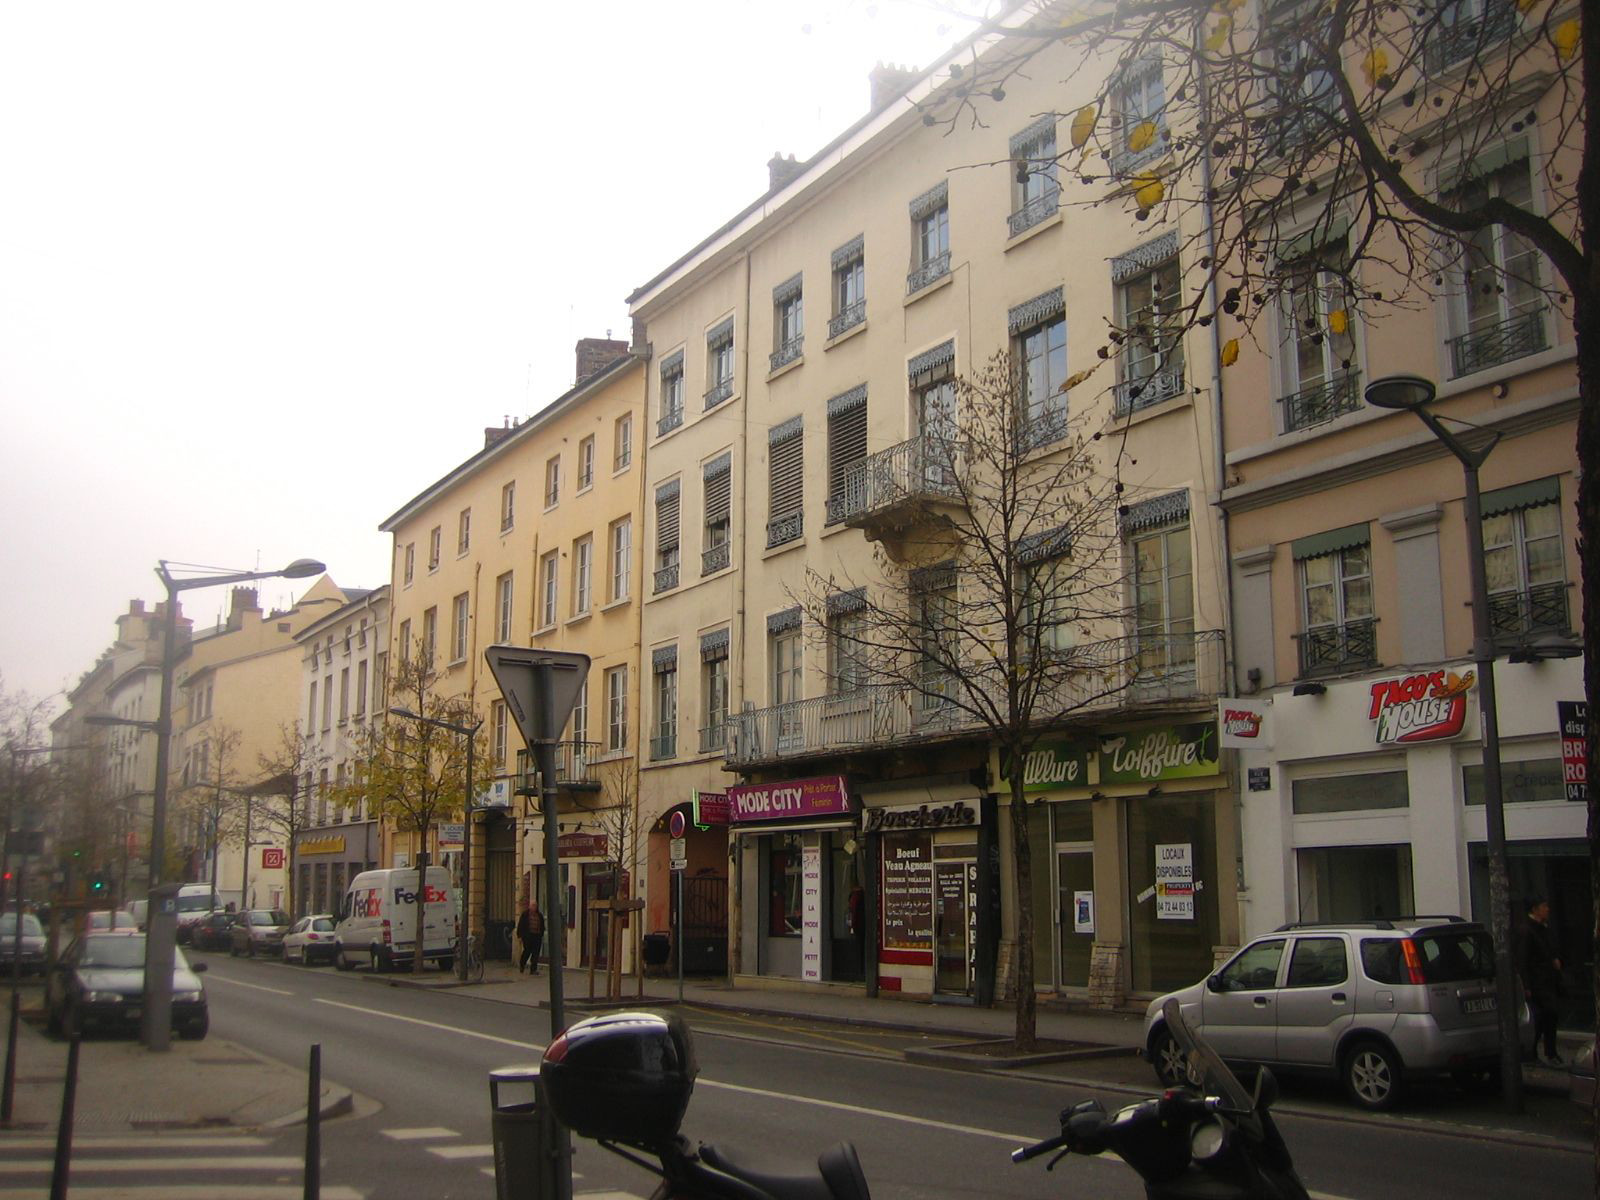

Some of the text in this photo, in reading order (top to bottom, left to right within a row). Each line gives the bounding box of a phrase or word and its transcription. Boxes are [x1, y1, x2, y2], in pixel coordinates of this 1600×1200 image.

[1369, 670, 1445, 720] TACO'S
[1376, 698, 1452, 743] HOUSE
[1103, 731, 1197, 778] Coiffure
[736, 787, 803, 814] MODE CITY
[896, 848, 920, 858] Boeuf
[1162, 848, 1185, 860] LOCAUX
[885, 861, 932, 873] Veau Agneau
[1157, 866, 1192, 878] DISPONIBLES
[394, 885, 448, 905] FeEx
